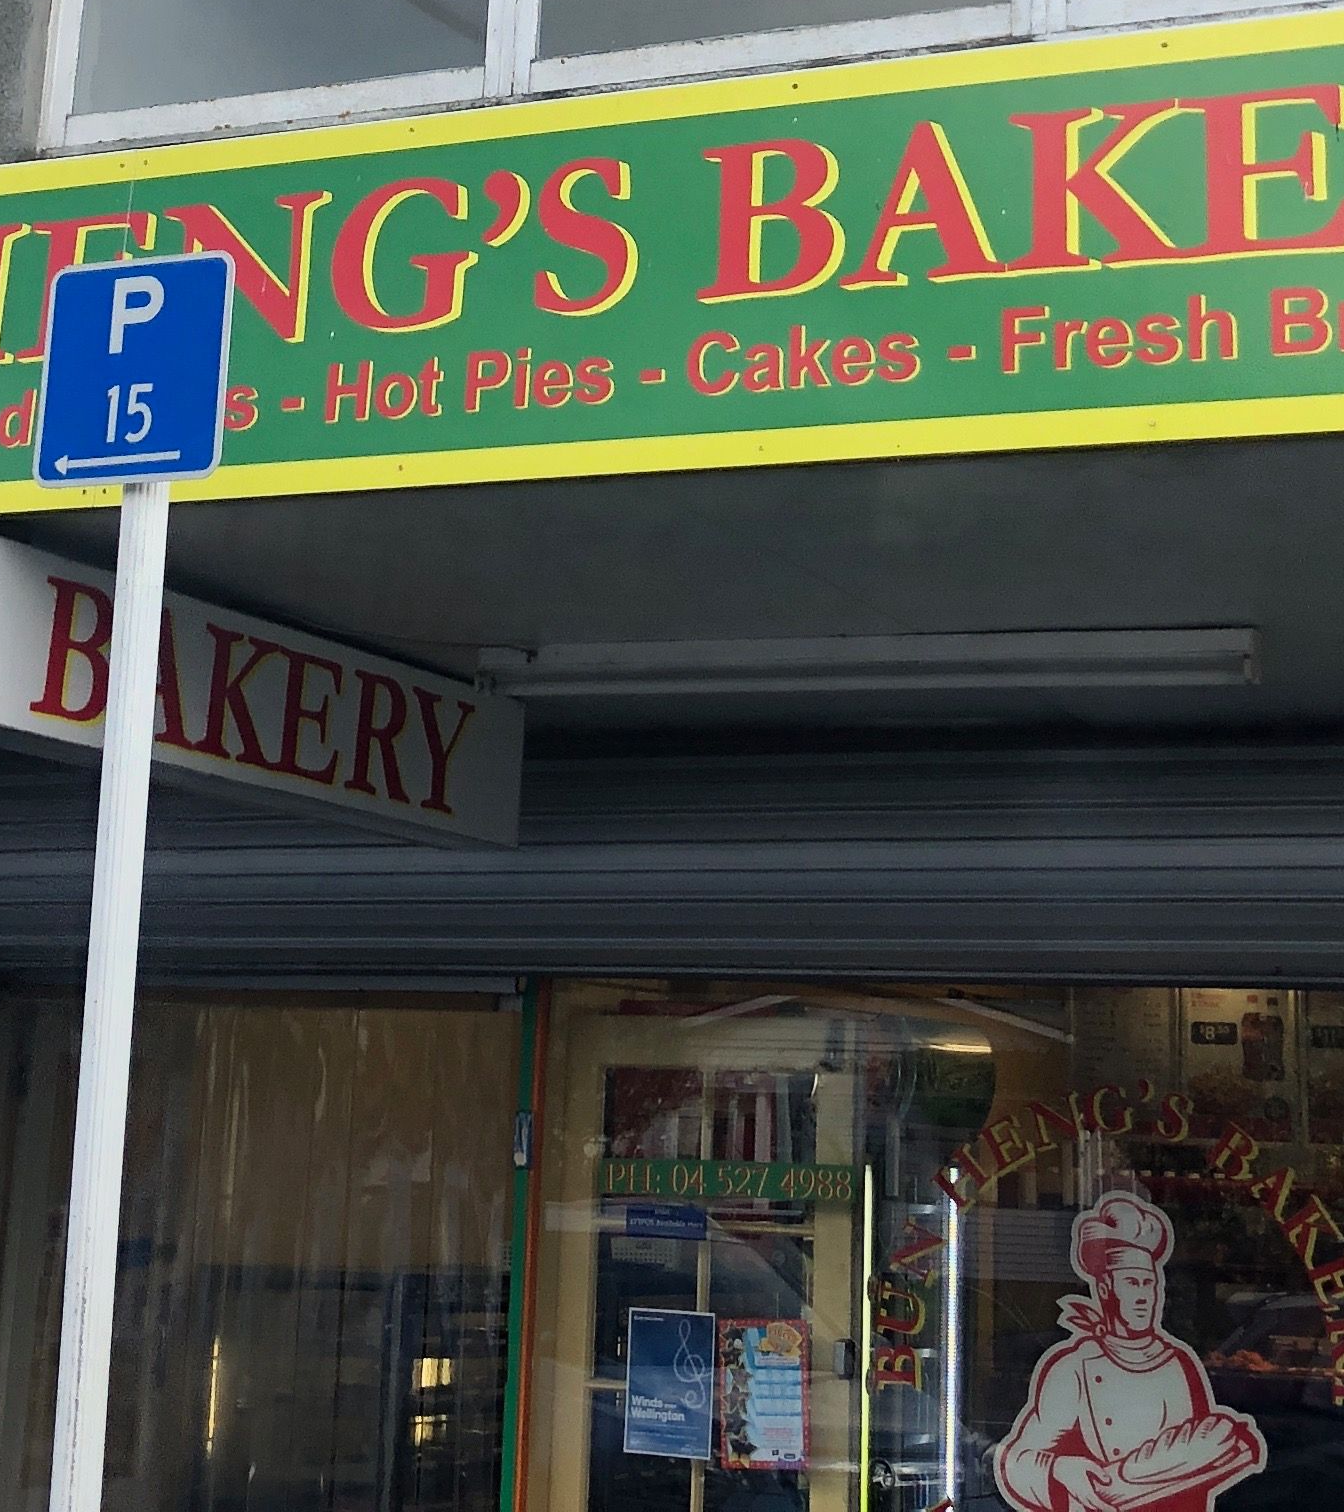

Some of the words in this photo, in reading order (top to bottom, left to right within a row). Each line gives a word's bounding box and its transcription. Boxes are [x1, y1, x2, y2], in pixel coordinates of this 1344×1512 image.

[108, 276, 165, 354] P
[323, 356, 444, 424] Hot
[465, 346, 614, 414] Pies
[687, 325, 920, 397] Cakes
[1000, 293, 1239, 375] Fresh
[106, 383, 154, 444] 15
[607, 1163, 660, 1194] PH:
[672, 1164, 706, 1197] 04
[718, 1165, 769, 1198] 527
[780, 1168, 852, 1200] 4988
[872, 1217, 946, 1391] BUN
[933, 1080, 1195, 1213] HENG'S
[630, 1405, 685, 1422] Wellington
[631, 1394, 663, 1409] Winds
